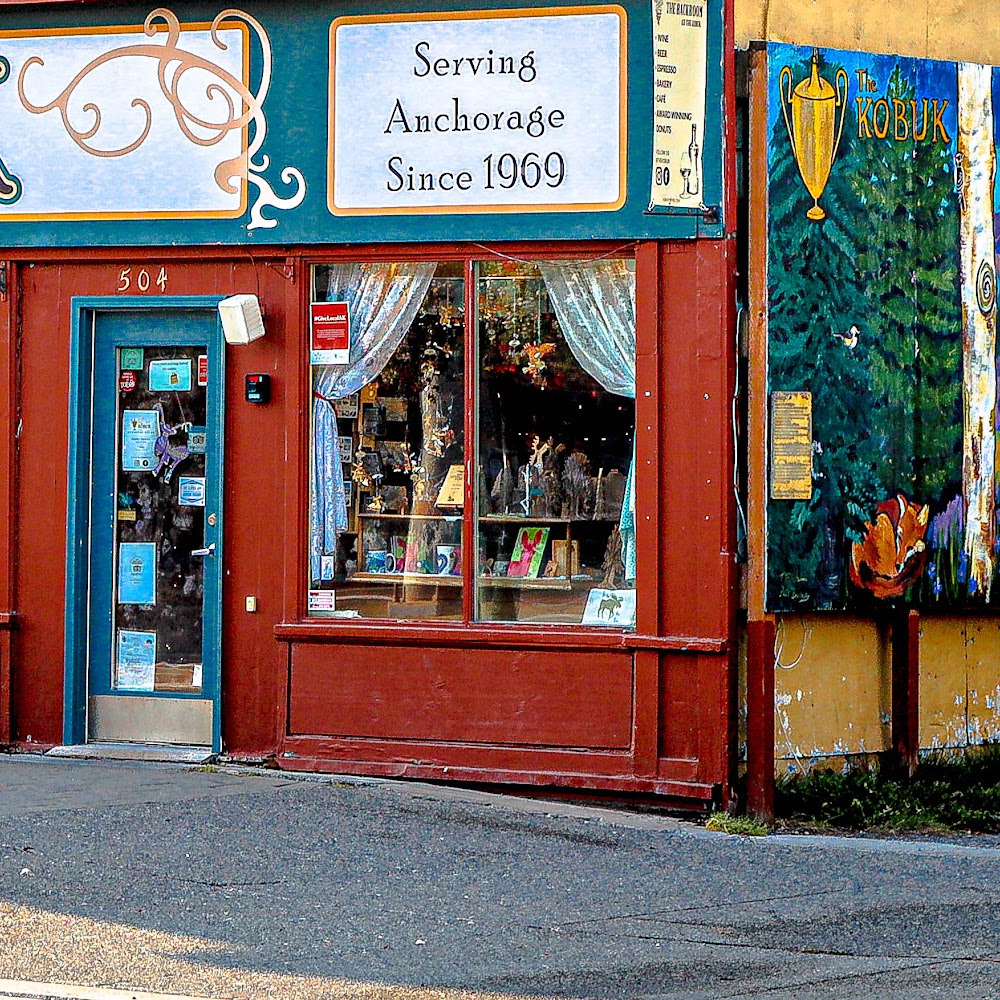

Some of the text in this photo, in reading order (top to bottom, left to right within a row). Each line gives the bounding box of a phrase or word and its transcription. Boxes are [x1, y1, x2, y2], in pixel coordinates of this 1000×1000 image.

[413, 41, 537, 83] Serving
[657, 49, 668, 58] BEER
[656, 64, 677, 74] ESPRESSO
[854, 69, 878, 93] The
[656, 79, 672, 89] BAKERY
[383, 97, 565, 138] Anchorage
[656, 109, 692, 121] AWARD WINNING
[855, 96, 951, 143] KOBUK
[656, 124, 672, 134] DONUTS
[387, 151, 566, 192] Since 1969
[117, 266, 169, 293] 504
